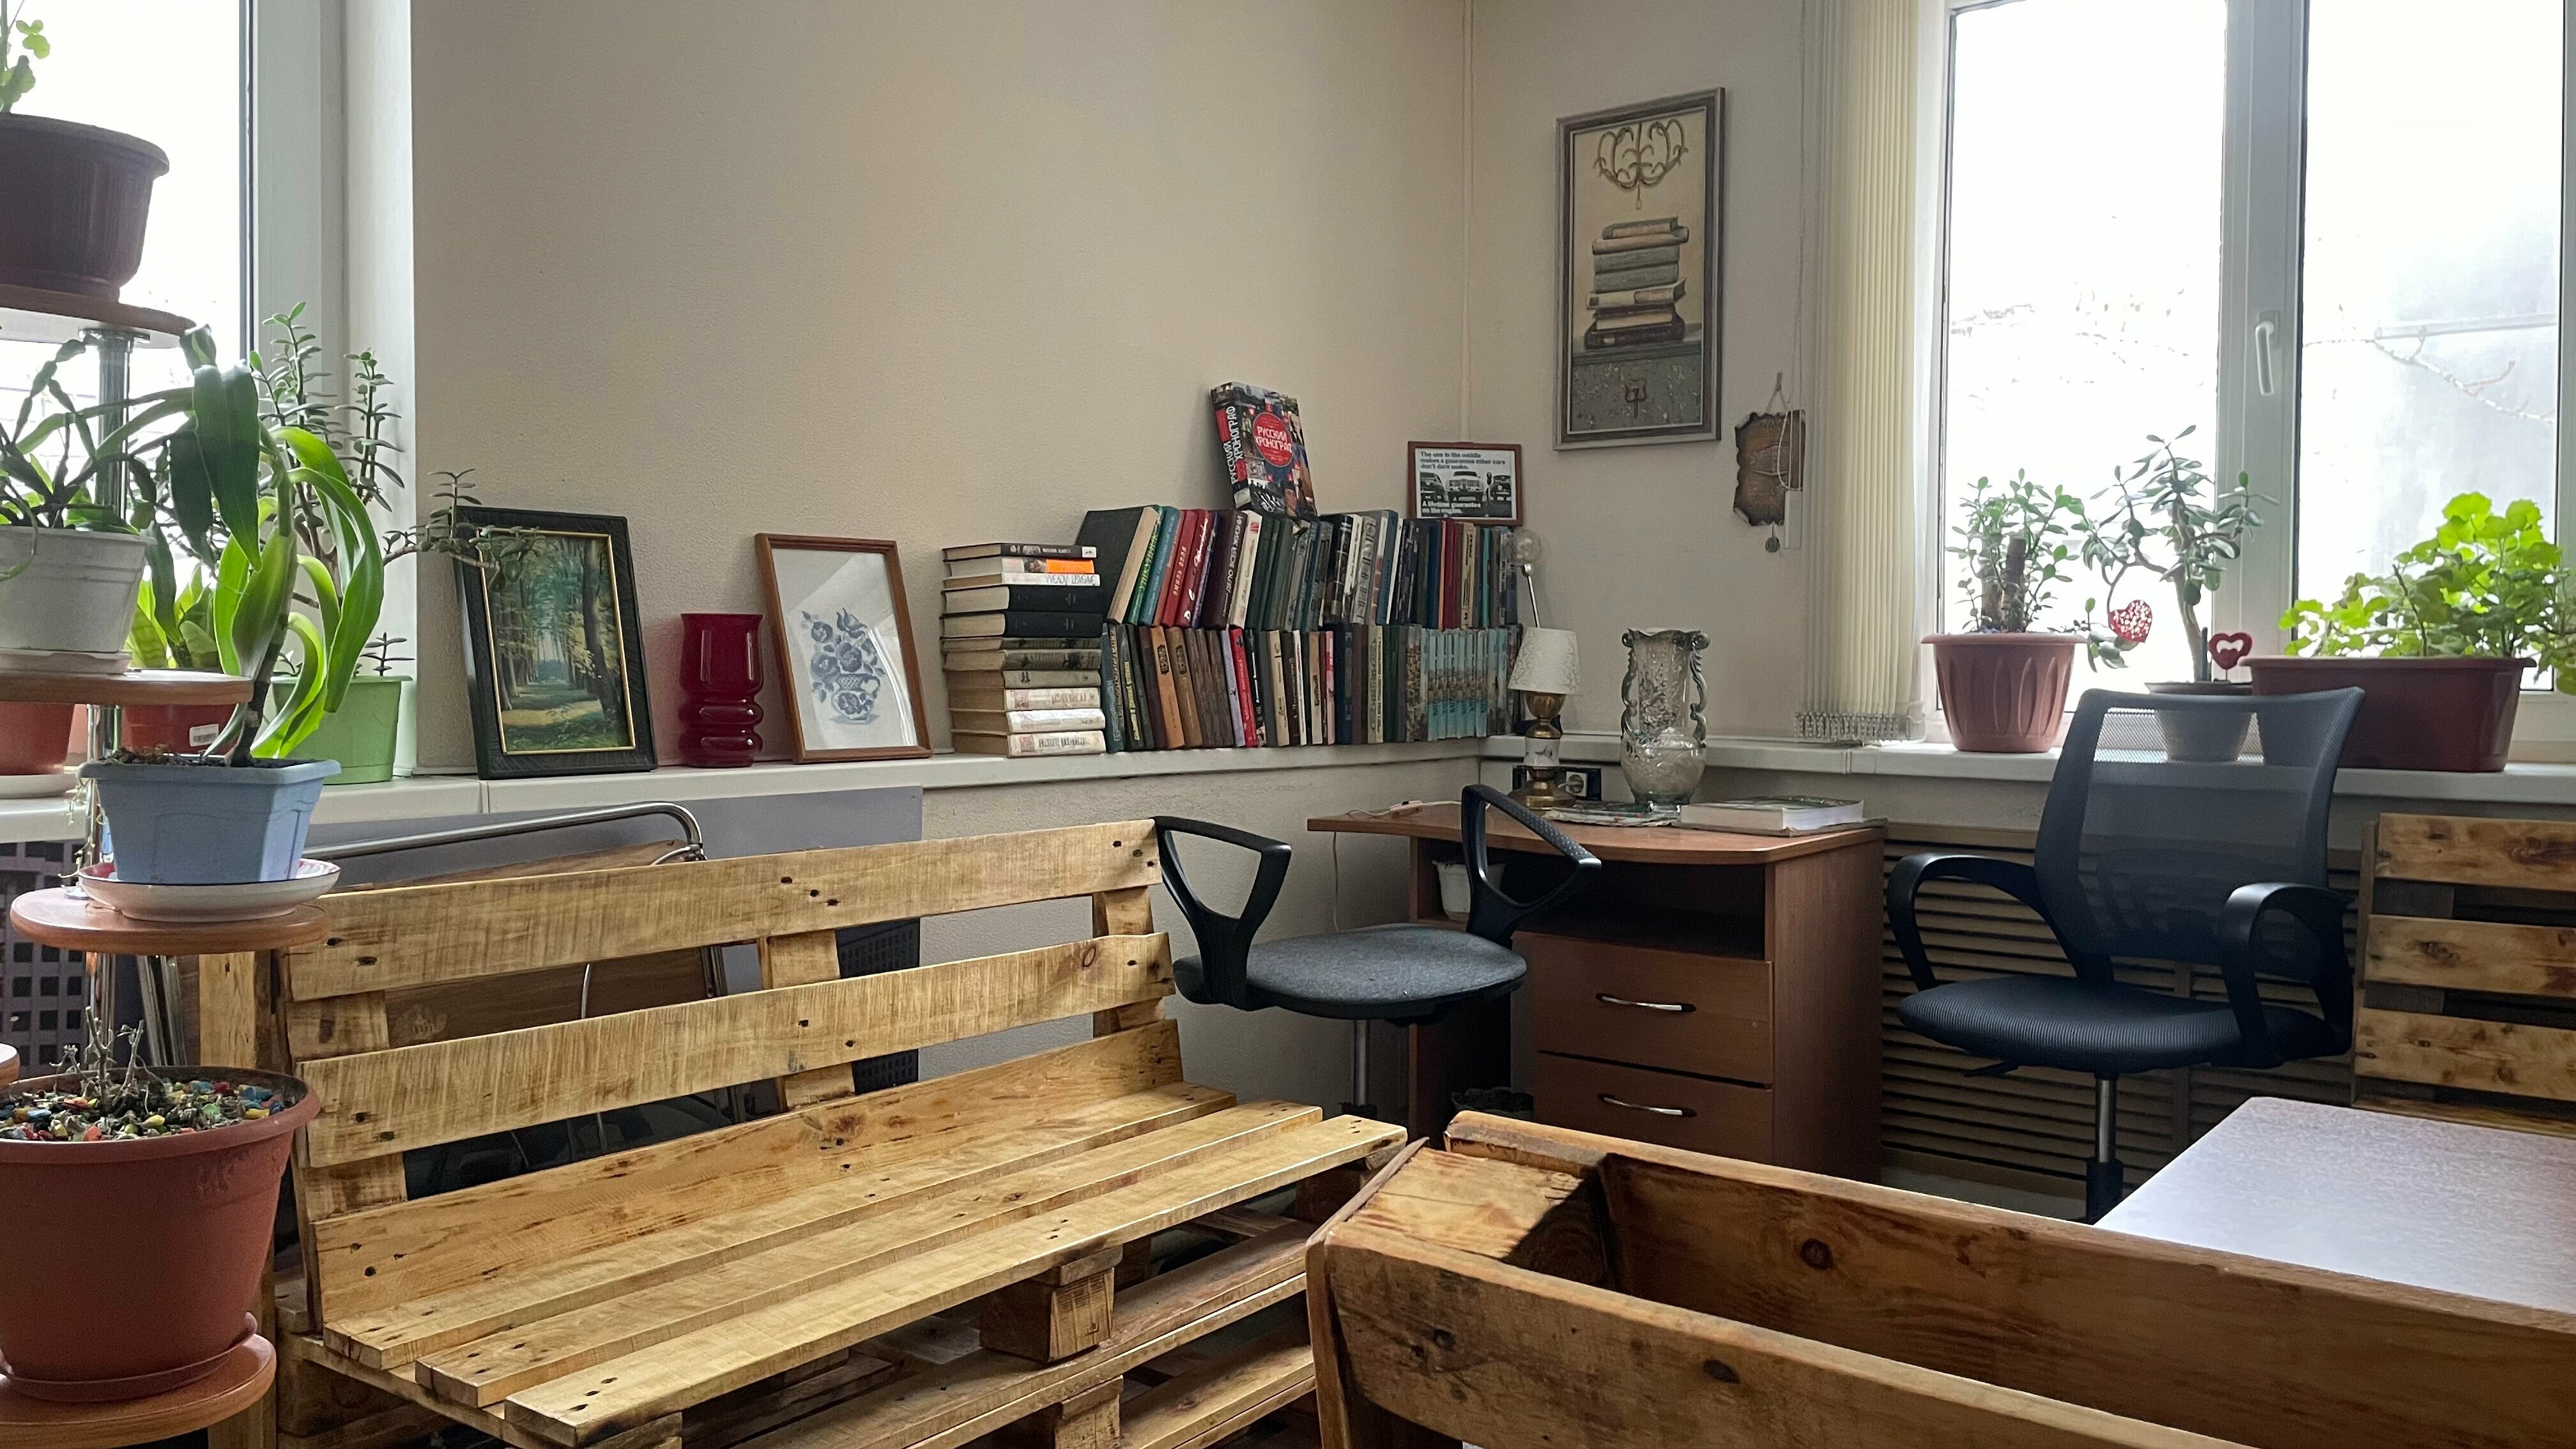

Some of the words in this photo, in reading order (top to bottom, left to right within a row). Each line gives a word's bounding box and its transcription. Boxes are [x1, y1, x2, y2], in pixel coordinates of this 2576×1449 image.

[1225, 406, 1243, 460] ХРОНОГРАФ
[1255, 435, 1292, 453] ХРОНОГРАФ
[1257, 425, 1287, 442] РУССКИЙ
[1223, 441, 1238, 484] РУССКИЙ
[1232, 515, 1243, 546] ЖИЗНИ
[1229, 546, 1238, 568] ВСЕЙ
[1225, 569, 1234, 593] ДЕЛО
